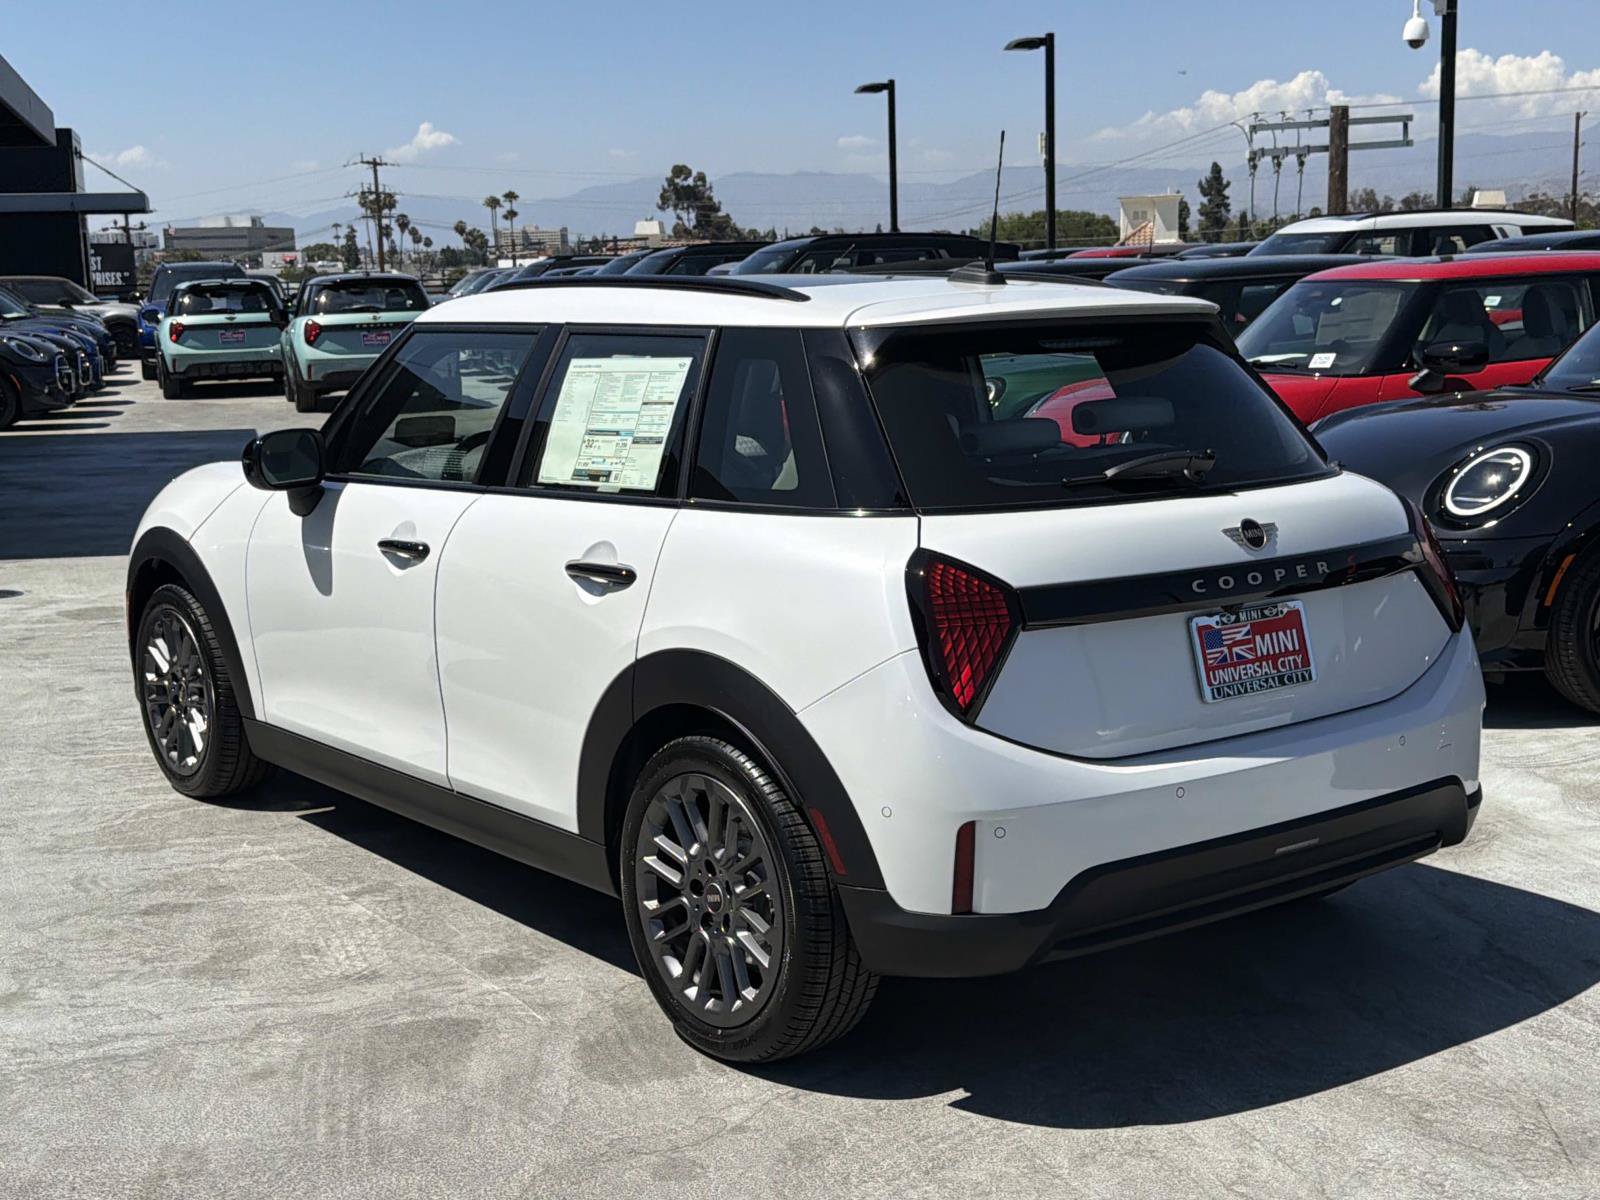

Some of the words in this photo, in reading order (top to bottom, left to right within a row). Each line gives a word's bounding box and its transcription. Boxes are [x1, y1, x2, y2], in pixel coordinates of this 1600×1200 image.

[1244, 527, 1263, 540] MINI
[1191, 561, 1330, 593] COOPER
[1346, 554, 1358, 575] S
[1239, 609, 1262, 621] MINI
[1255, 629, 1300, 657] MINI
[1209, 661, 1277, 685] UNIVERSAL
[1277, 655, 1303, 672] CITY
[1213, 677, 1281, 699] UNIVERSAL
[1283, 670, 1311, 685] CITY
